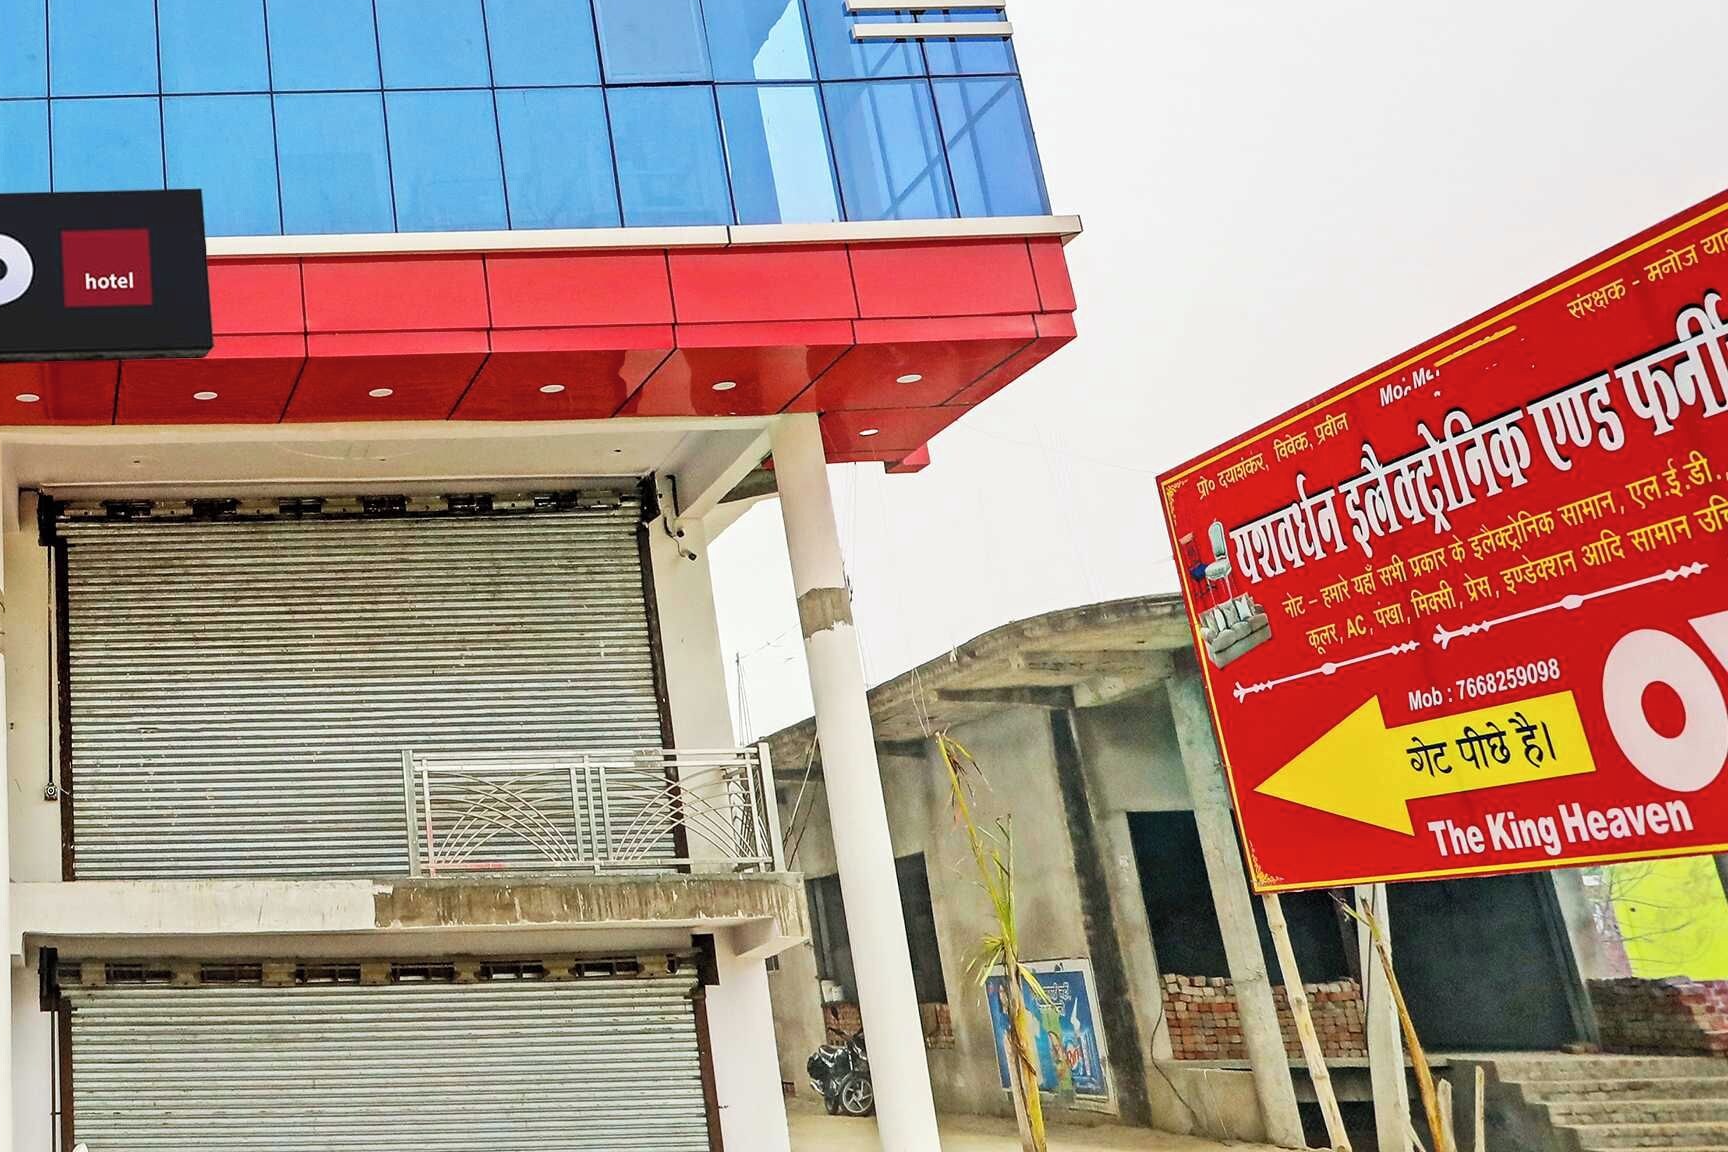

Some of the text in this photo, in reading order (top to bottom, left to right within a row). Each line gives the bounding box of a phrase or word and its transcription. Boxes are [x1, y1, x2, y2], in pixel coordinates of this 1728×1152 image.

[84, 272, 135, 290] hotel
[1566, 278, 1626, 319] संरक्षक
[1643, 244, 1698, 282] मनोज
[1700, 227, 1728, 254] या
[1229, 473, 1348, 584] यशवर्धन
[1526, 373, 1625, 472] एण्ड
[1614, 293, 1728, 436] फर्नी
[1314, 412, 1349, 445] प्रवीन
[1581, 529, 1625, 566] आदि
[1627, 515, 1692, 552] सामान
[1282, 592, 1306, 618] नोट
[1320, 575, 1351, 608] हमारे
[1351, 564, 1376, 596] यहाँ
[1377, 554, 1407, 587] सभी
[1408, 547, 1448, 578] प्रकार
[1448, 534, 1466, 563] के
[1408, 687, 1443, 711] Mob
[1455, 658, 1561, 700] 7668259098
[1406, 736, 1453, 777] गेट
[1456, 721, 1511, 769] पीछे
[1427, 799, 1694, 856] The King Heaven
